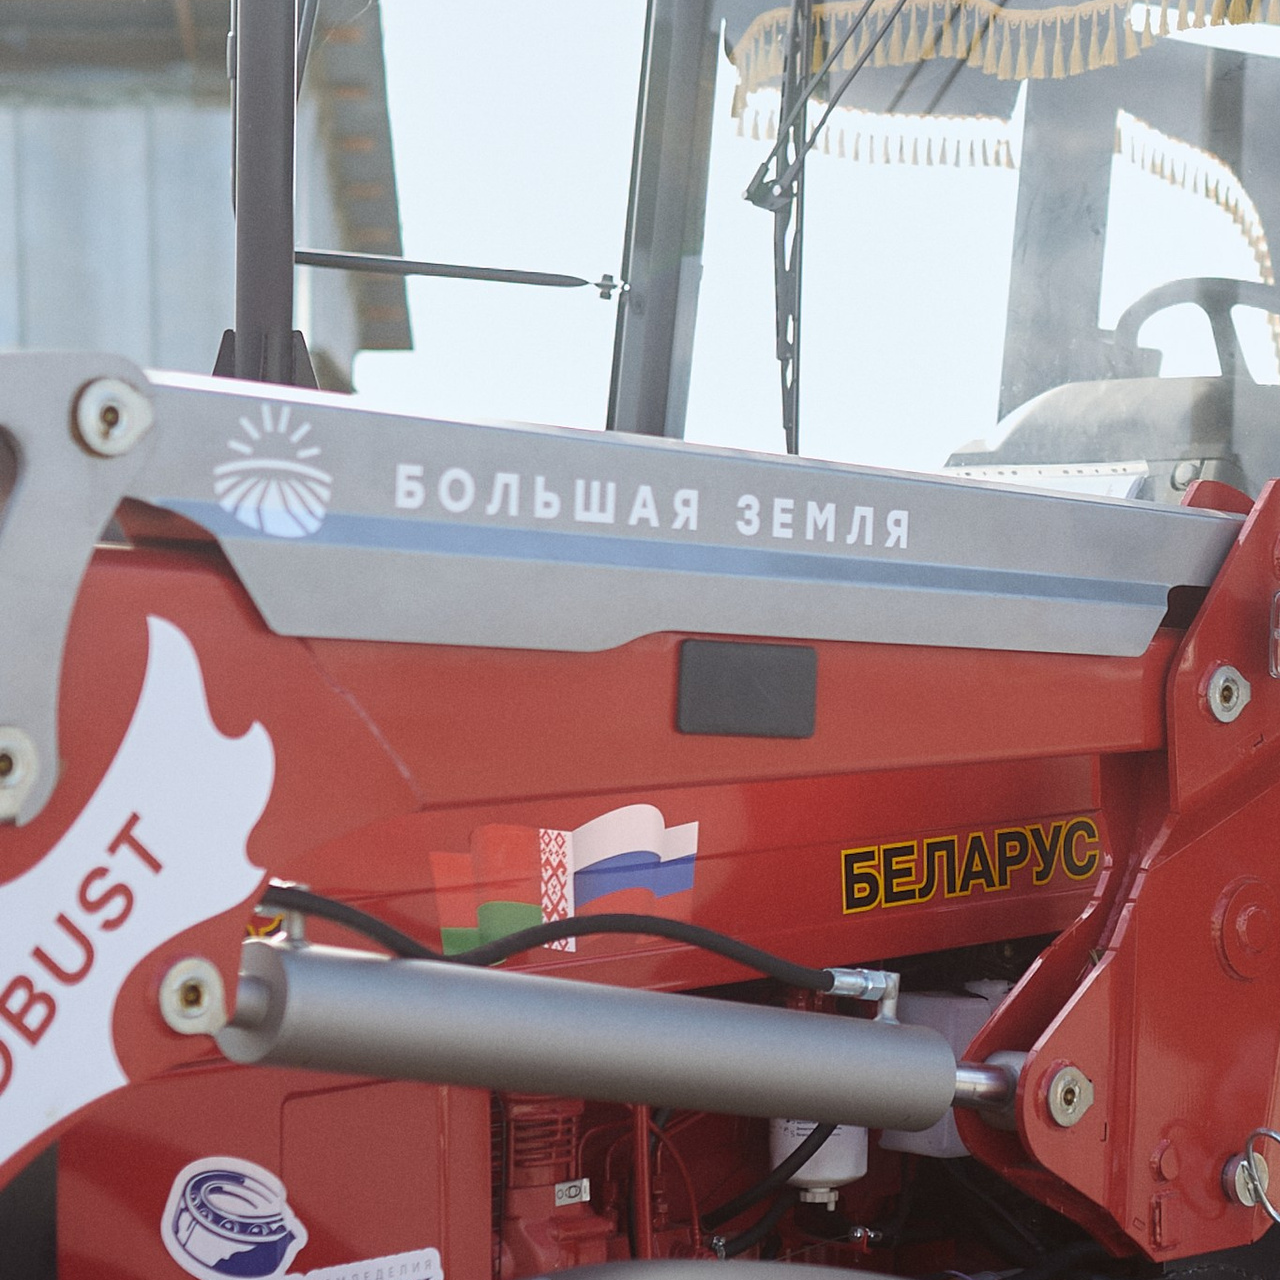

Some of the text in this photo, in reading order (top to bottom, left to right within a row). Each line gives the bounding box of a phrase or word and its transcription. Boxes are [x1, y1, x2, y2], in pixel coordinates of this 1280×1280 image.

[395, 464, 909, 550] БОЛЬШАЯ ЗЕМЛЯ
[841, 816, 1100, 915] БЕЛАРУС
[0, 811, 164, 1102] BUST
